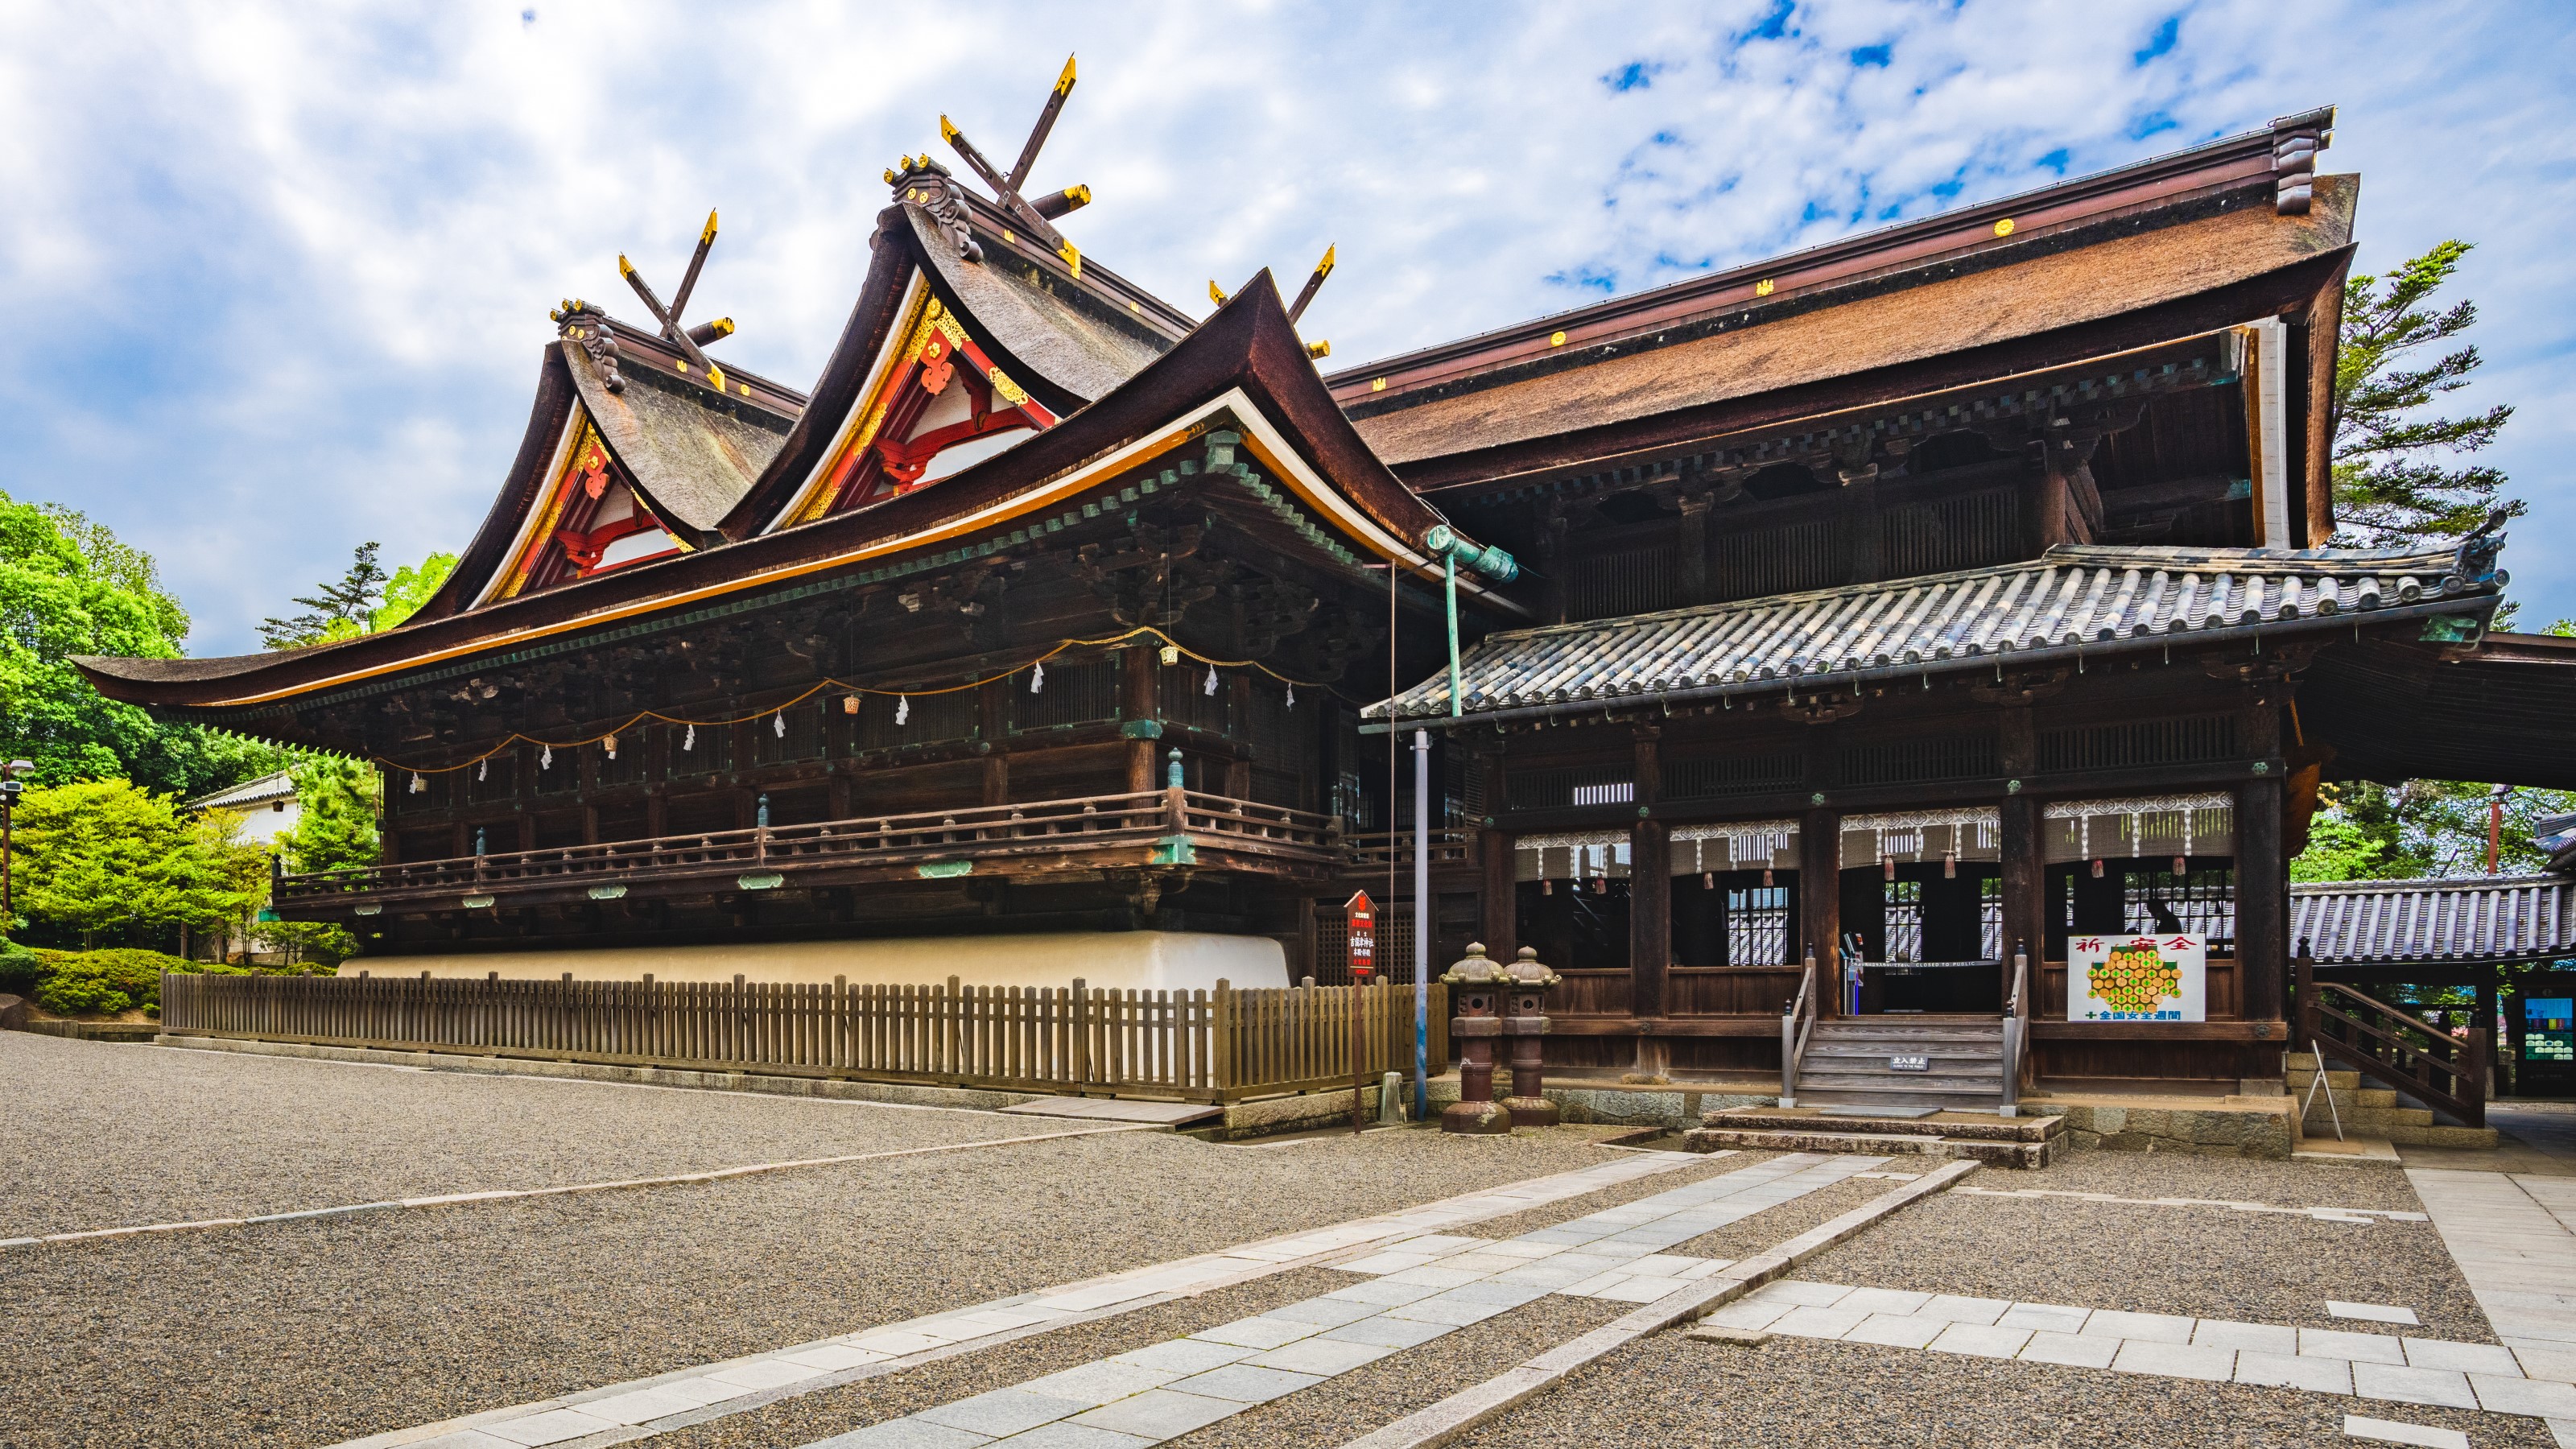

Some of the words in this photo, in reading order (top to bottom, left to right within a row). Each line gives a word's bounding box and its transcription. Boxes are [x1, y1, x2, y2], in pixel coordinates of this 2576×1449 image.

[1350, 936, 1374, 947] 吉備津神社
[2075, 938, 2105, 953] 祈
[2099, 1010, 2182, 1021] 全国安全週間
